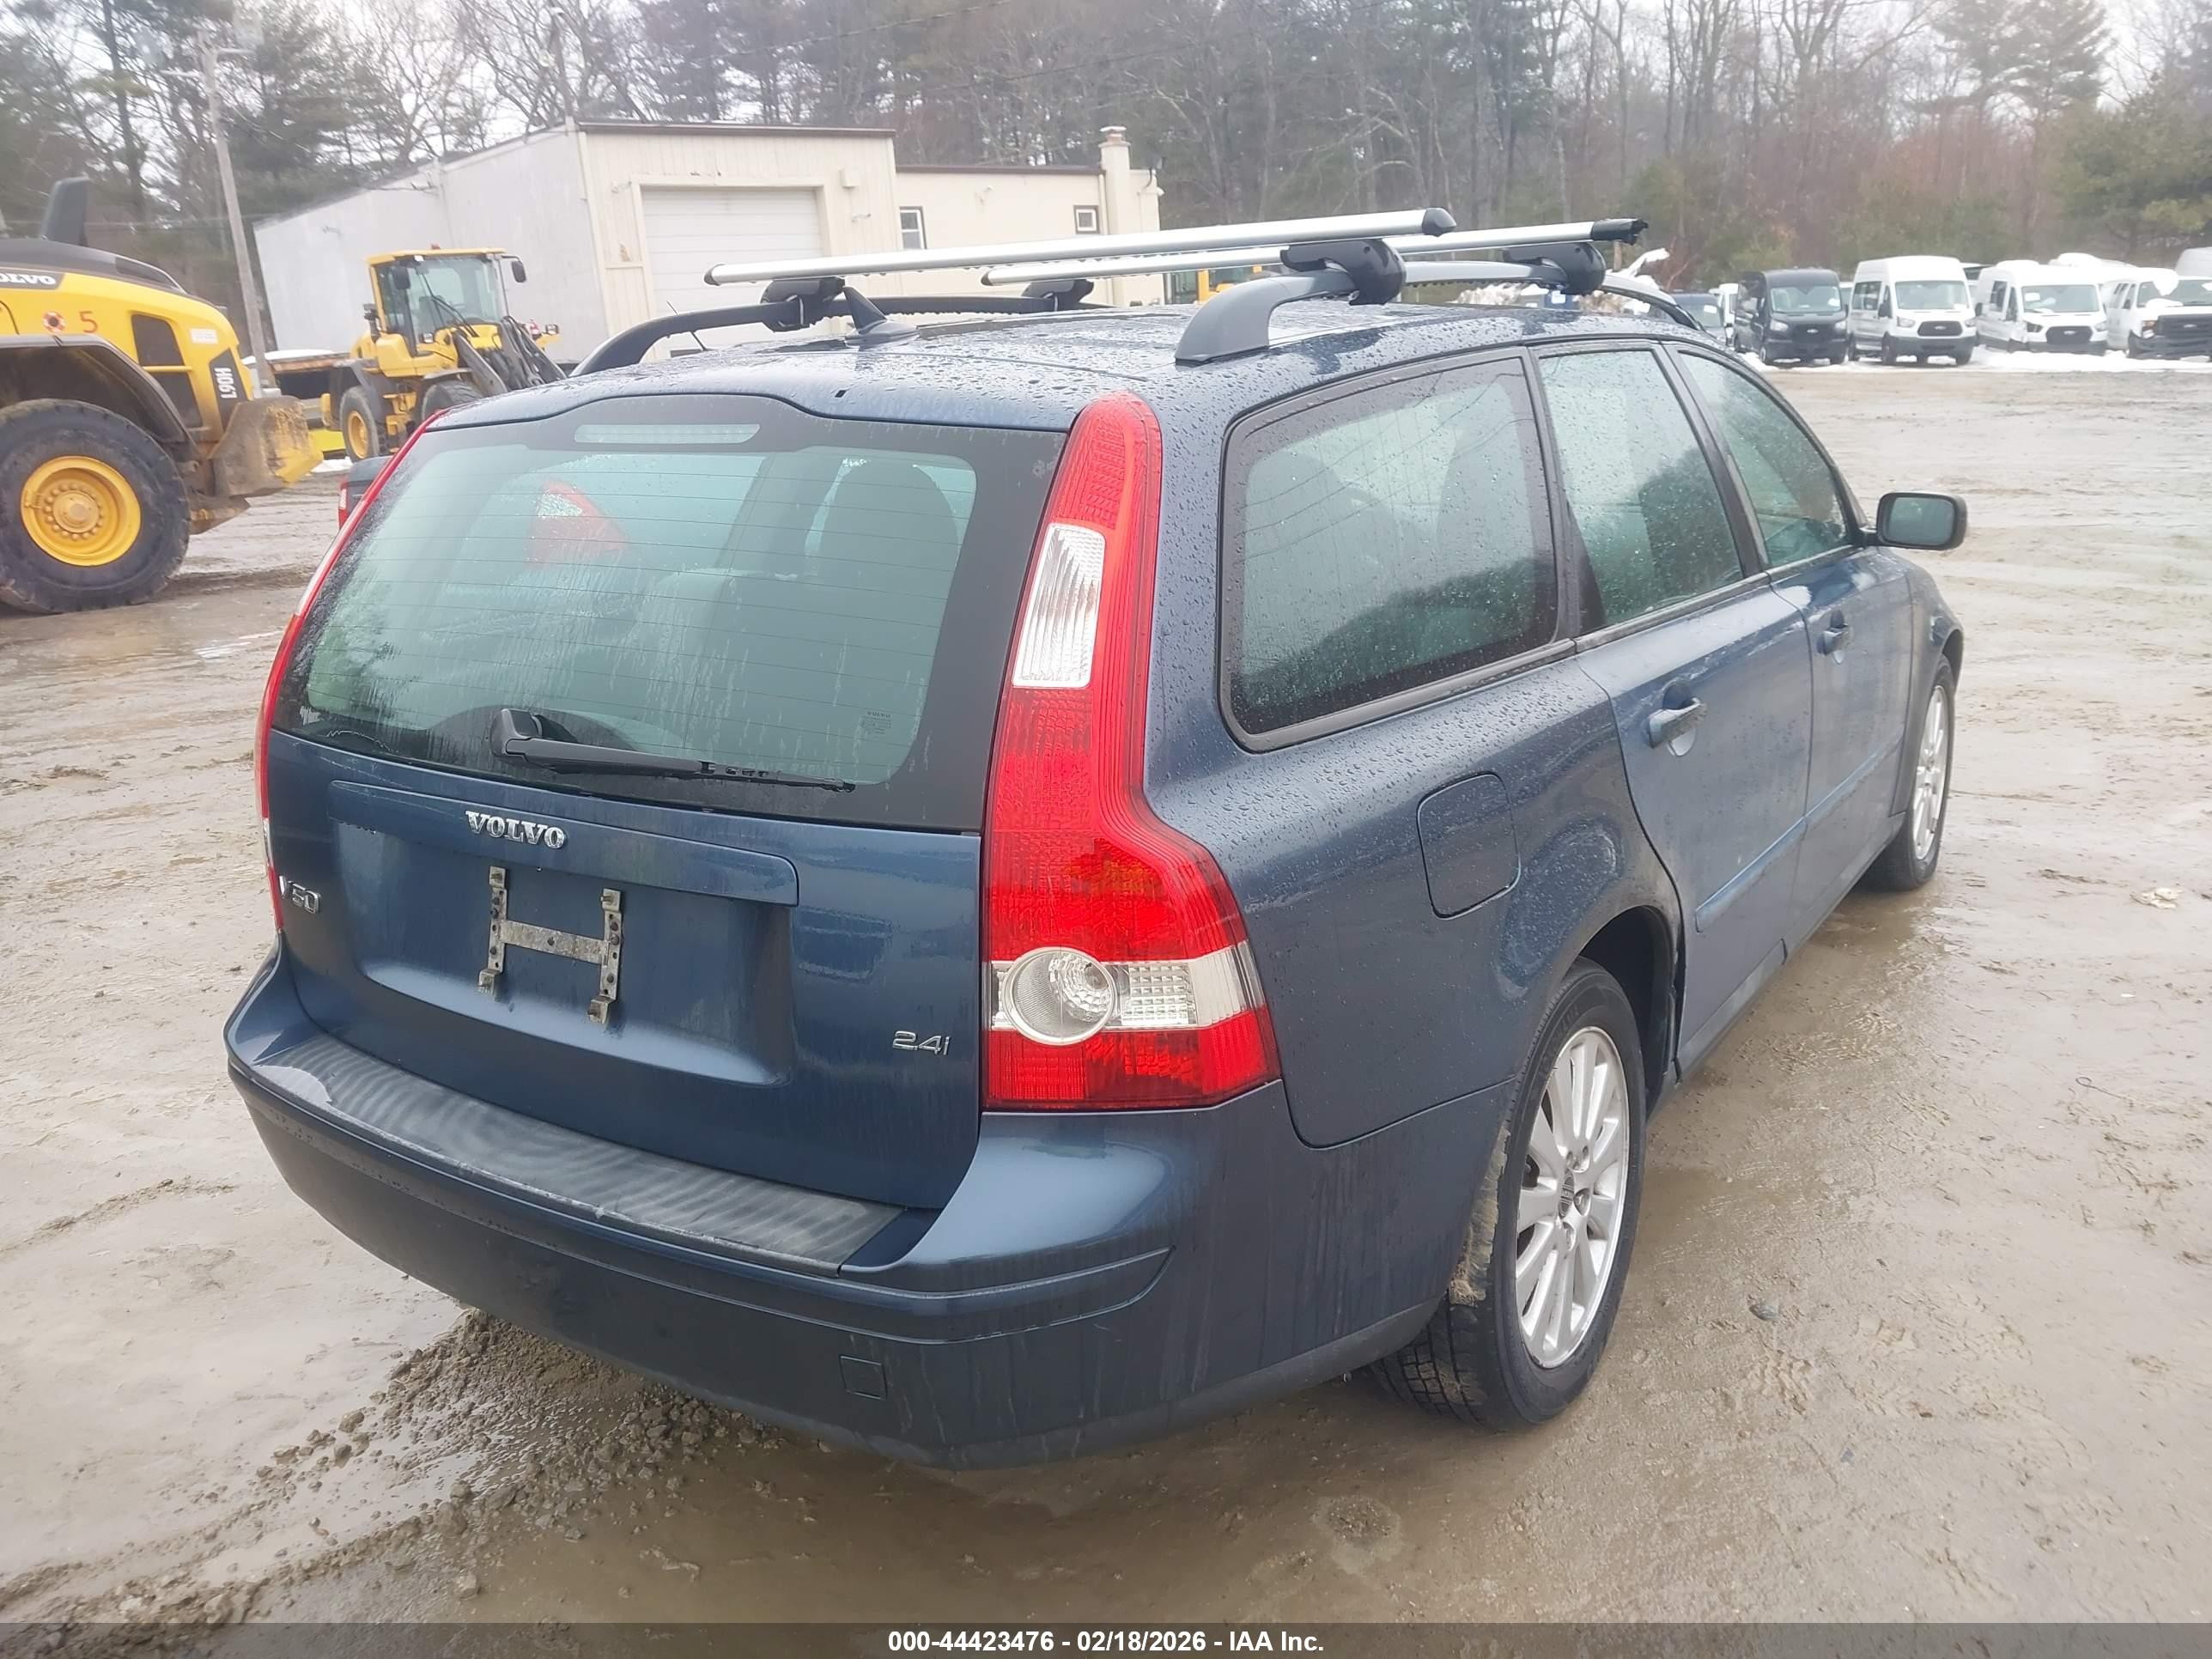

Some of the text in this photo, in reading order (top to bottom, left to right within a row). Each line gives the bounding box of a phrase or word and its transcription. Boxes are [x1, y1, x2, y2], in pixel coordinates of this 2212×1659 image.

[0, 272, 57, 285] OLVO
[79, 310, 99, 333] 5
[214, 367, 238, 399] L90H
[465, 810, 566, 849] VOLVO
[892, 1030, 951, 1056] 2.4i
